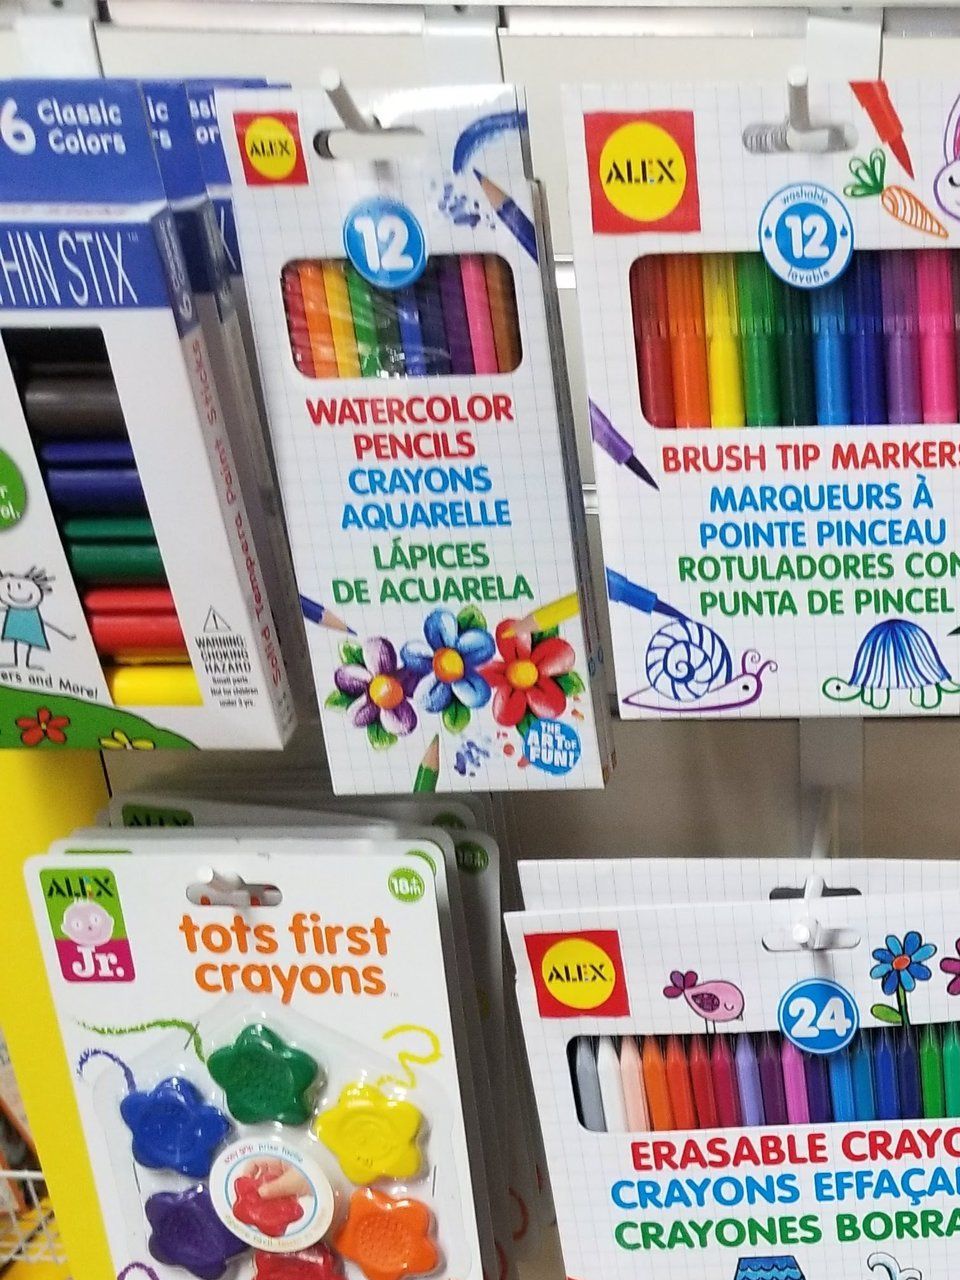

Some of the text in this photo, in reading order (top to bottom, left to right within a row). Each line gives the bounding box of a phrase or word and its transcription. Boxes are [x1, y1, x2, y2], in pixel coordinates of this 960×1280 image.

[2, 97, 122, 155] 6 Classic
[48, 127, 126, 155] Colors
[249, 135, 291, 158] ALEX
[605, 158, 676, 186] ALEX
[783, 186, 829, 205] washable
[354, 215, 413, 273] 12
[785, 214, 829, 259] 12
[788, 265, 830, 284] lavable
[306, 394, 514, 426] WATERCOLOR
[353, 432, 476, 459] PENCILS
[662, 445, 766, 472] BRUSH
[776, 444, 819, 471] TIP
[349, 465, 493, 495] CRAYONS
[709, 474, 933, 513] MARQUEURS À
[341, 499, 512, 531] AQUARELLE
[700, 518, 946, 549] POINTE PINCEAU
[372, 537, 490, 571] LÁPICES
[678, 553, 894, 582] ROTULADORES
[331, 574, 535, 604] DE ACUARELA
[701, 587, 955, 616] PUNTA DE PINCEL
[46, 877, 116, 900] ALEX
[179, 913, 392, 955] tots first
[70, 945, 126, 979] Jr.
[547, 964, 609, 985] ALEX
[195, 962, 388, 1005] crayons
[788, 1000, 851, 1038] 24
[631, 1132, 828, 1171] ERASABLE
[611, 1172, 800, 1210] CRAYONS
[615, 1211, 822, 1251] CRAYONES
